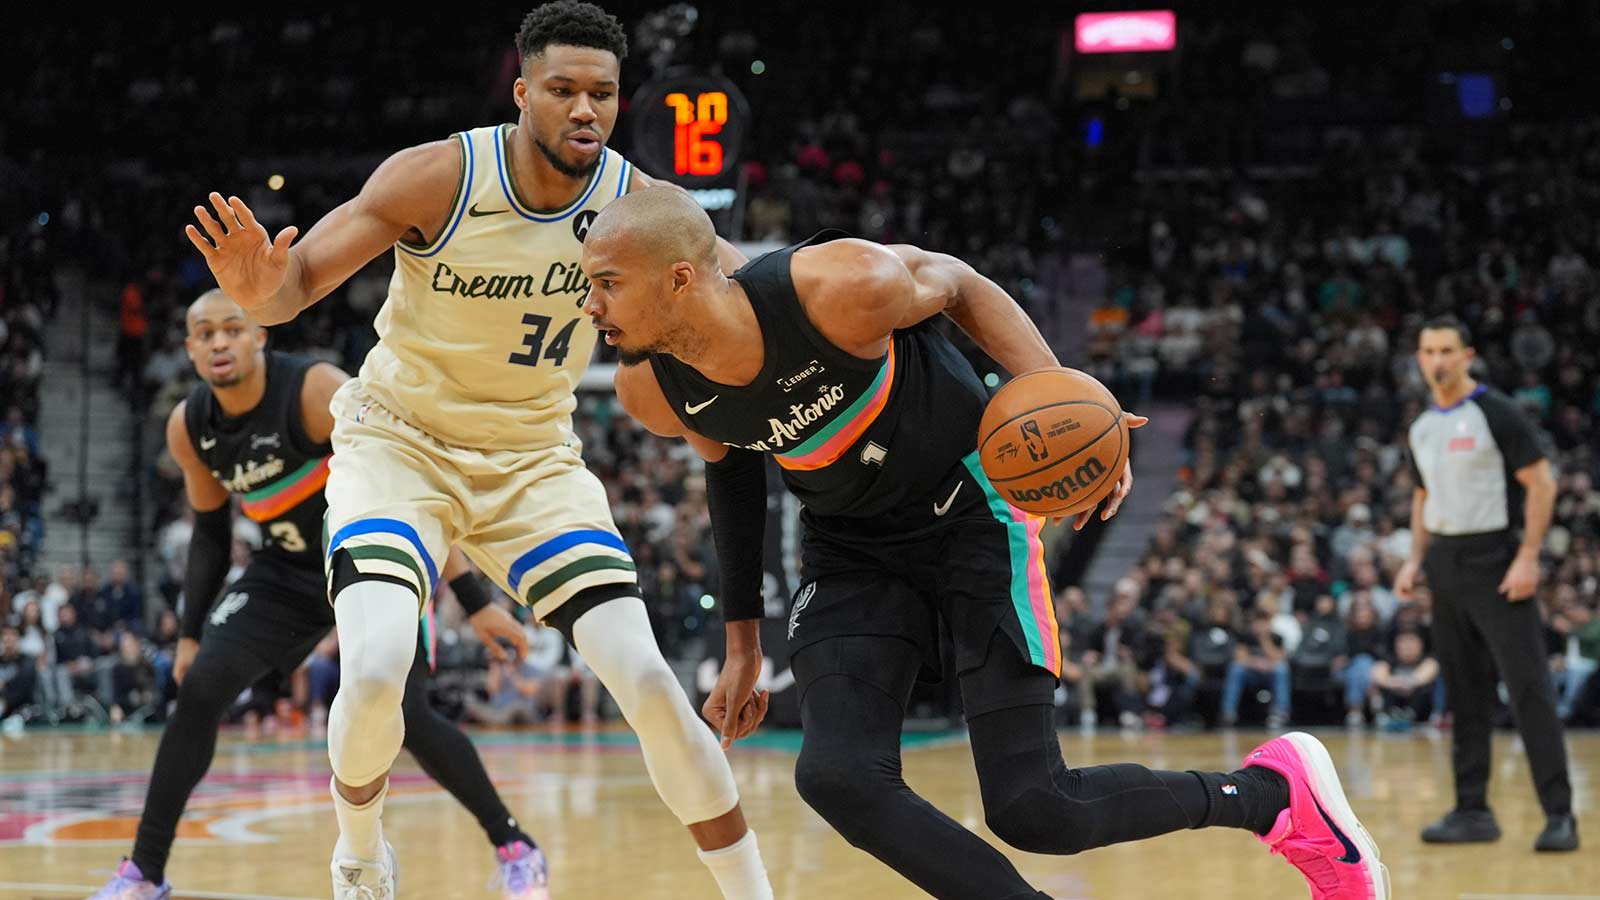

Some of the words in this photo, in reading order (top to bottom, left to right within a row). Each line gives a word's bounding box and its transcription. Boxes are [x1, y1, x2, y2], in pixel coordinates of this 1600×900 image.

[674, 121, 723, 176] 16
[432, 262, 534, 300] Cream
[508, 312, 581, 367] 34
[784, 365, 818, 387] LEDGER
[768, 383, 845, 448] Antonio
[1008, 456, 1107, 502] Wilson
[269, 521, 306, 552] 3
